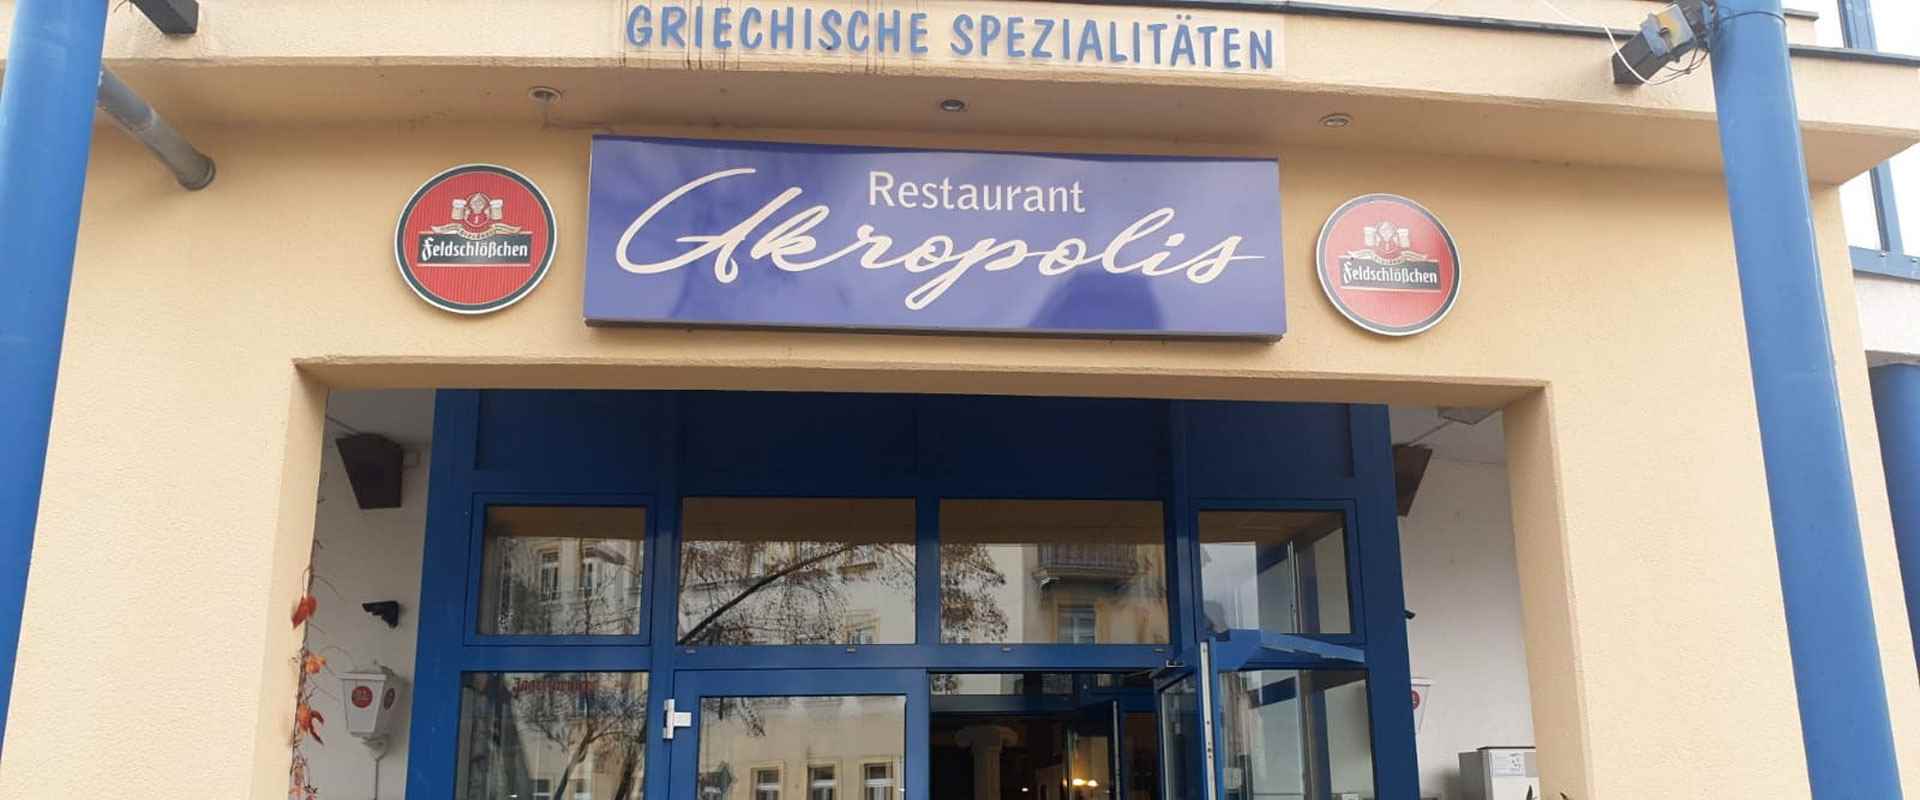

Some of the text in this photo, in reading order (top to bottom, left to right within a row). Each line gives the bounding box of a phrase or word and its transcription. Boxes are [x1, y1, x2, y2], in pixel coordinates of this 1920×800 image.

[625, 4, 1275, 70] GRIECHISCHE SPEZIALITÄTEN
[867, 170, 1086, 213] Restaurant
[422, 237, 528, 262] Feldschlößchen
[615, 168, 1265, 310] Akropolis
[1343, 261, 1438, 284] Feldschlößchen
